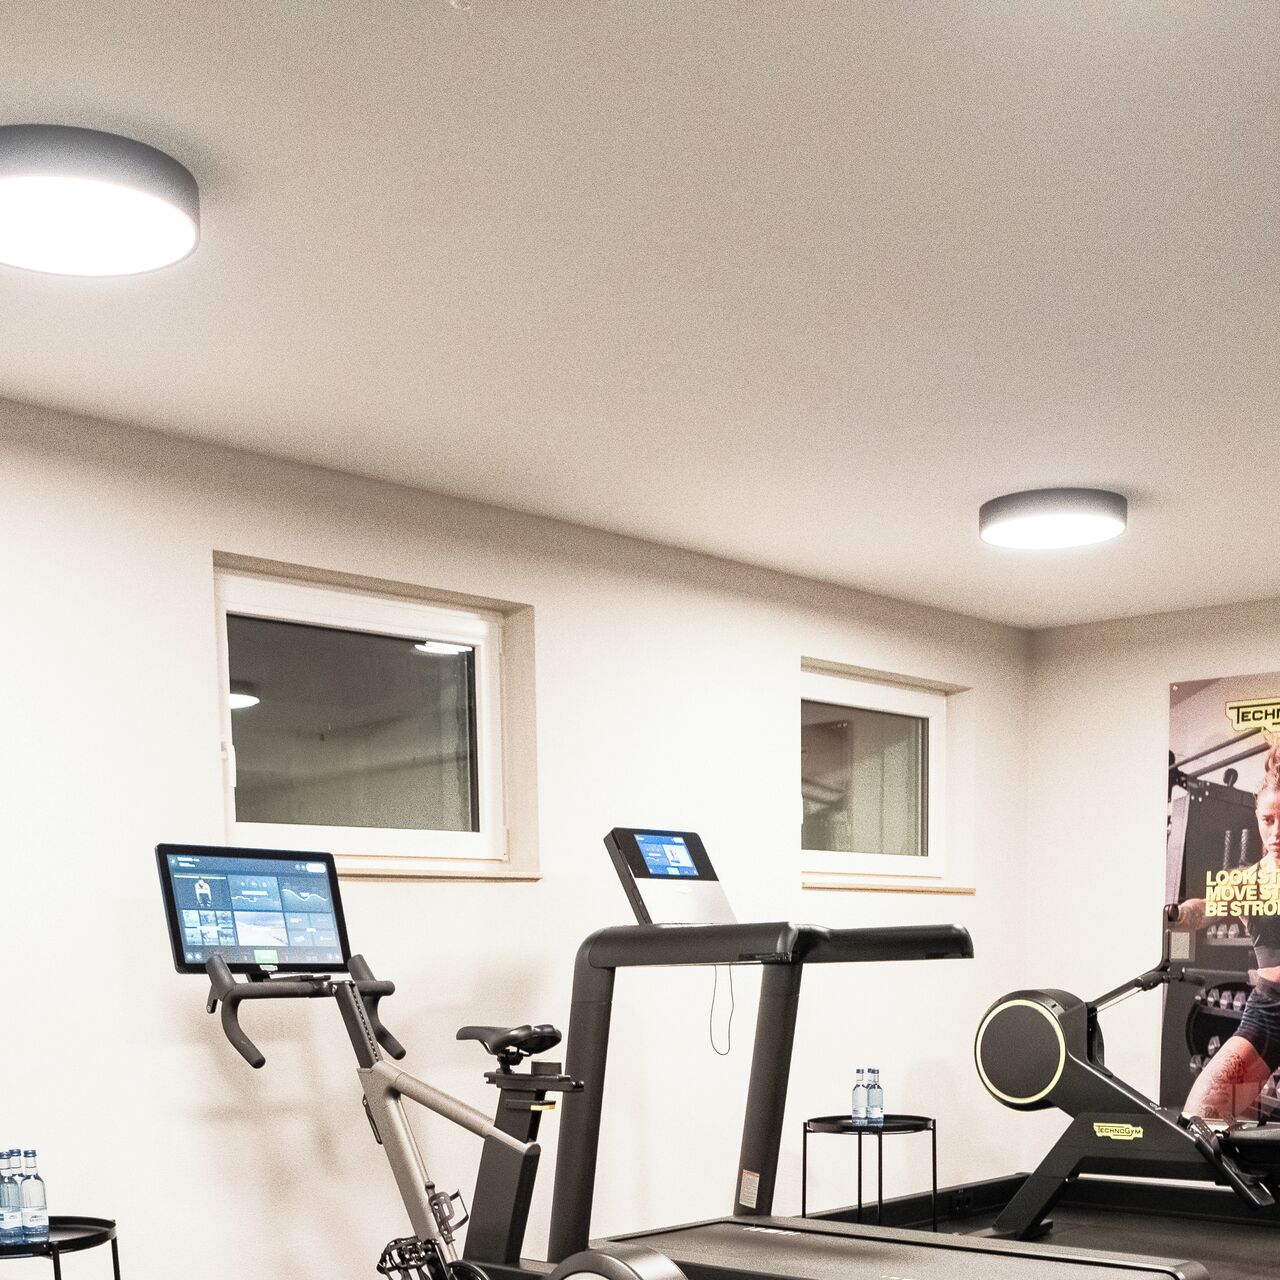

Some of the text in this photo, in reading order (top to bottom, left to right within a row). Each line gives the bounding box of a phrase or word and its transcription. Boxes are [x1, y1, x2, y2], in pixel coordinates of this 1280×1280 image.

[1206, 869, 1257, 886] LOOK
[1205, 884, 1258, 901] MOVE
[1205, 901, 1228, 917] BE
[1095, 1124, 1141, 1137] TECHNOGYM
